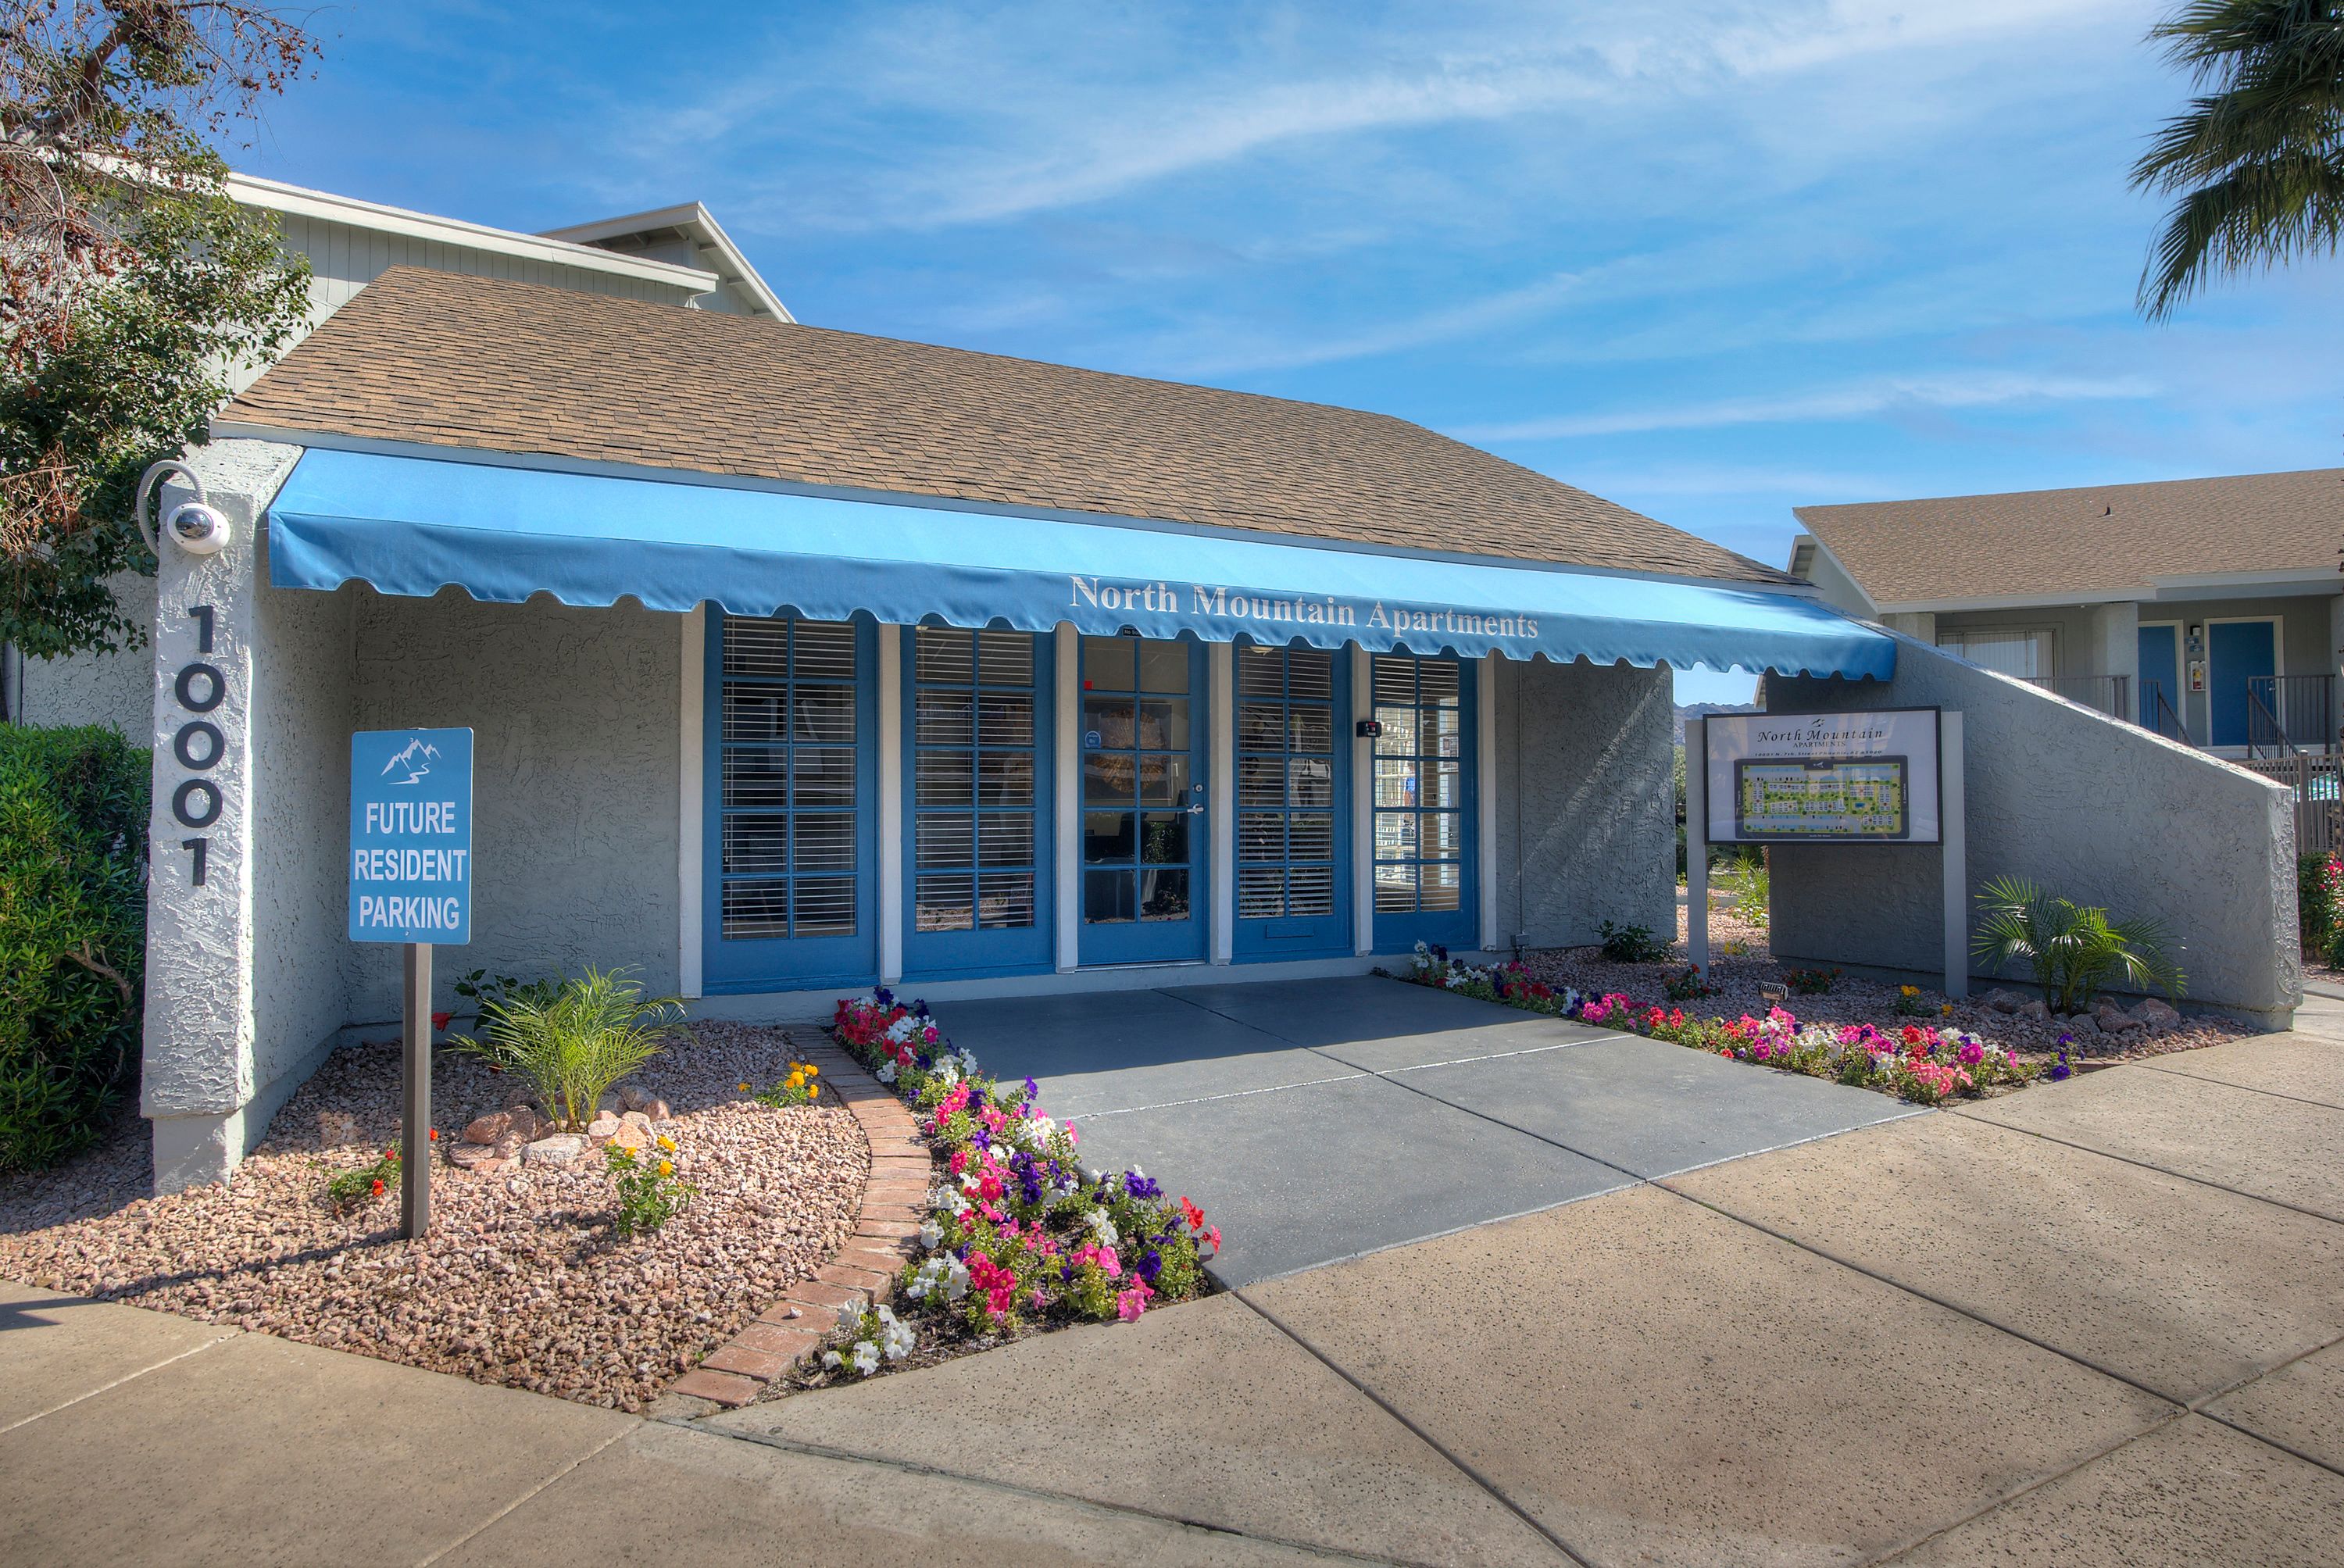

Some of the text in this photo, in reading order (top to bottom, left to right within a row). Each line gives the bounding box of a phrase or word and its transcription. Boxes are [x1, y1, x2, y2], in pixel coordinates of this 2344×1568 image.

[1069, 575, 1538, 638] North Mountain Apartments
[172, 605, 226, 886] 10001
[1757, 727, 1883, 742] North Mountain
[366, 802, 456, 834] FUTURE
[355, 848, 467, 881] RESIDENT
[359, 895, 459, 930] PARKING
